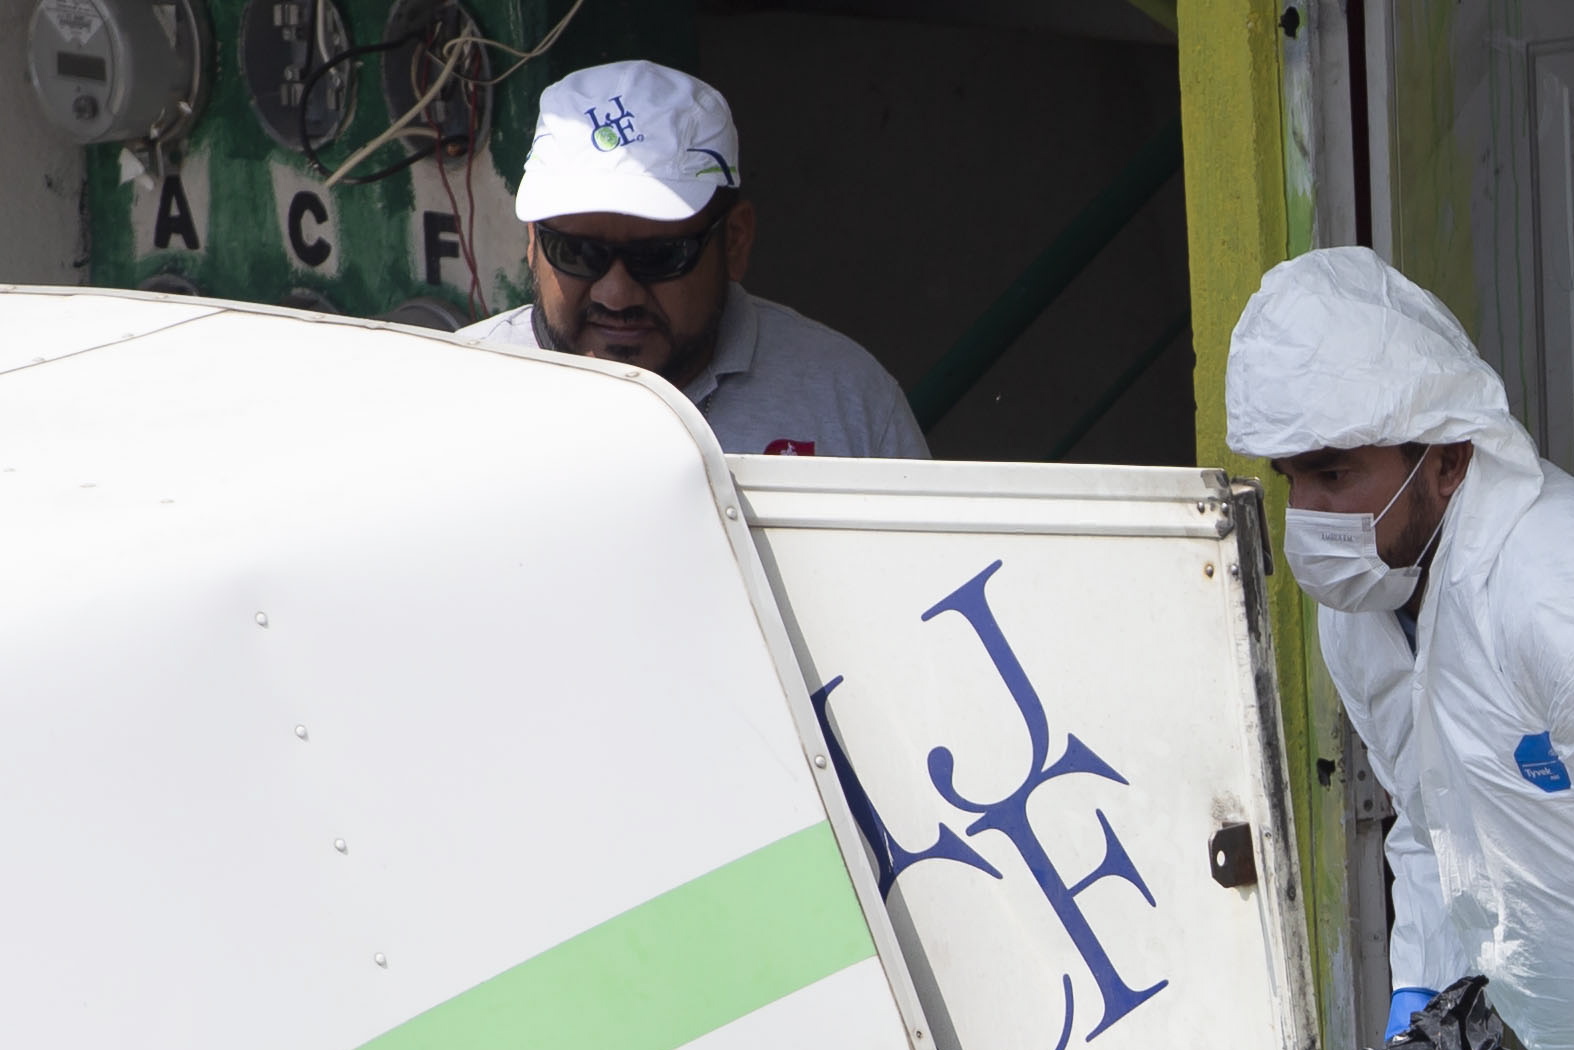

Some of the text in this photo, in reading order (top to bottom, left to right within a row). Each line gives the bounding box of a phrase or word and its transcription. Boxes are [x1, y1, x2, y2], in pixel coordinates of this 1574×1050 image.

[154, 176, 200, 250] A
[288, 190, 332, 267] C
[423, 211, 461, 285] F
